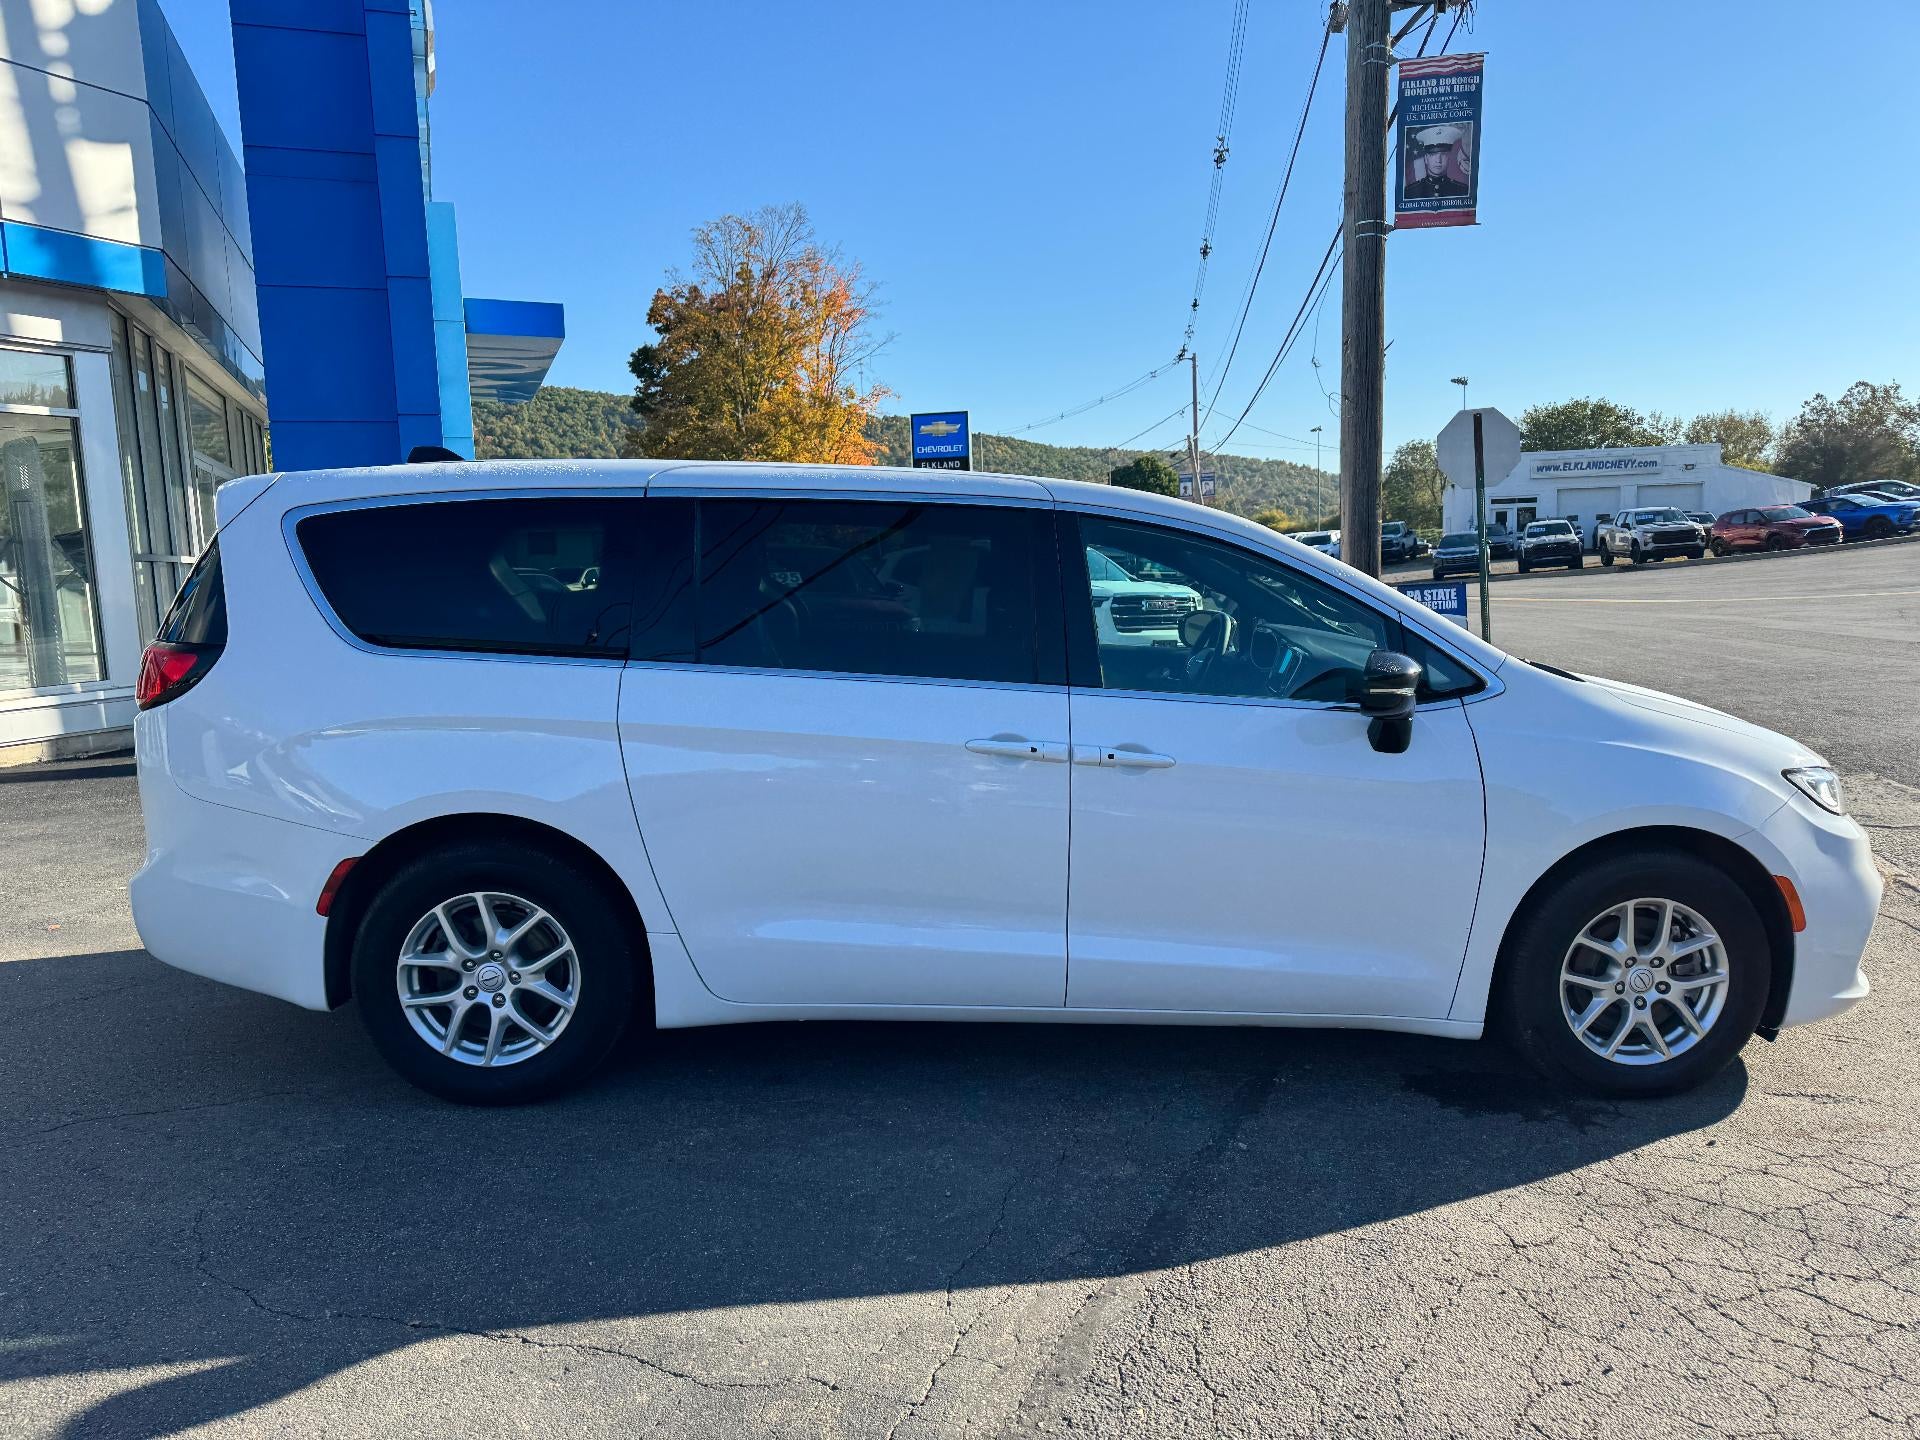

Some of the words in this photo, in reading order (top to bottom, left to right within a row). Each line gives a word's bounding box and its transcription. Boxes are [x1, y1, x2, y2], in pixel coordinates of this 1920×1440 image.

[1402, 79, 1436, 88] ELKLAND
[1440, 76, 1479, 85] BOROUGH
[1405, 86, 1450, 96] HOMETOWN
[1454, 84, 1475, 92] HERO
[1445, 100, 1468, 109] PLANK
[1420, 112, 1447, 121] MARINE
[1449, 110, 1473, 118] CORPS
[917, 445, 963, 454] CHEVROLET
[921, 460, 960, 468] ELKLAND
[1536, 458, 1658, 473] www.ELKLANDCHEVY.com
[1406, 590, 1421, 601] PA
[1424, 588, 1457, 601] STATE
[1422, 600, 1457, 609] PECTION
